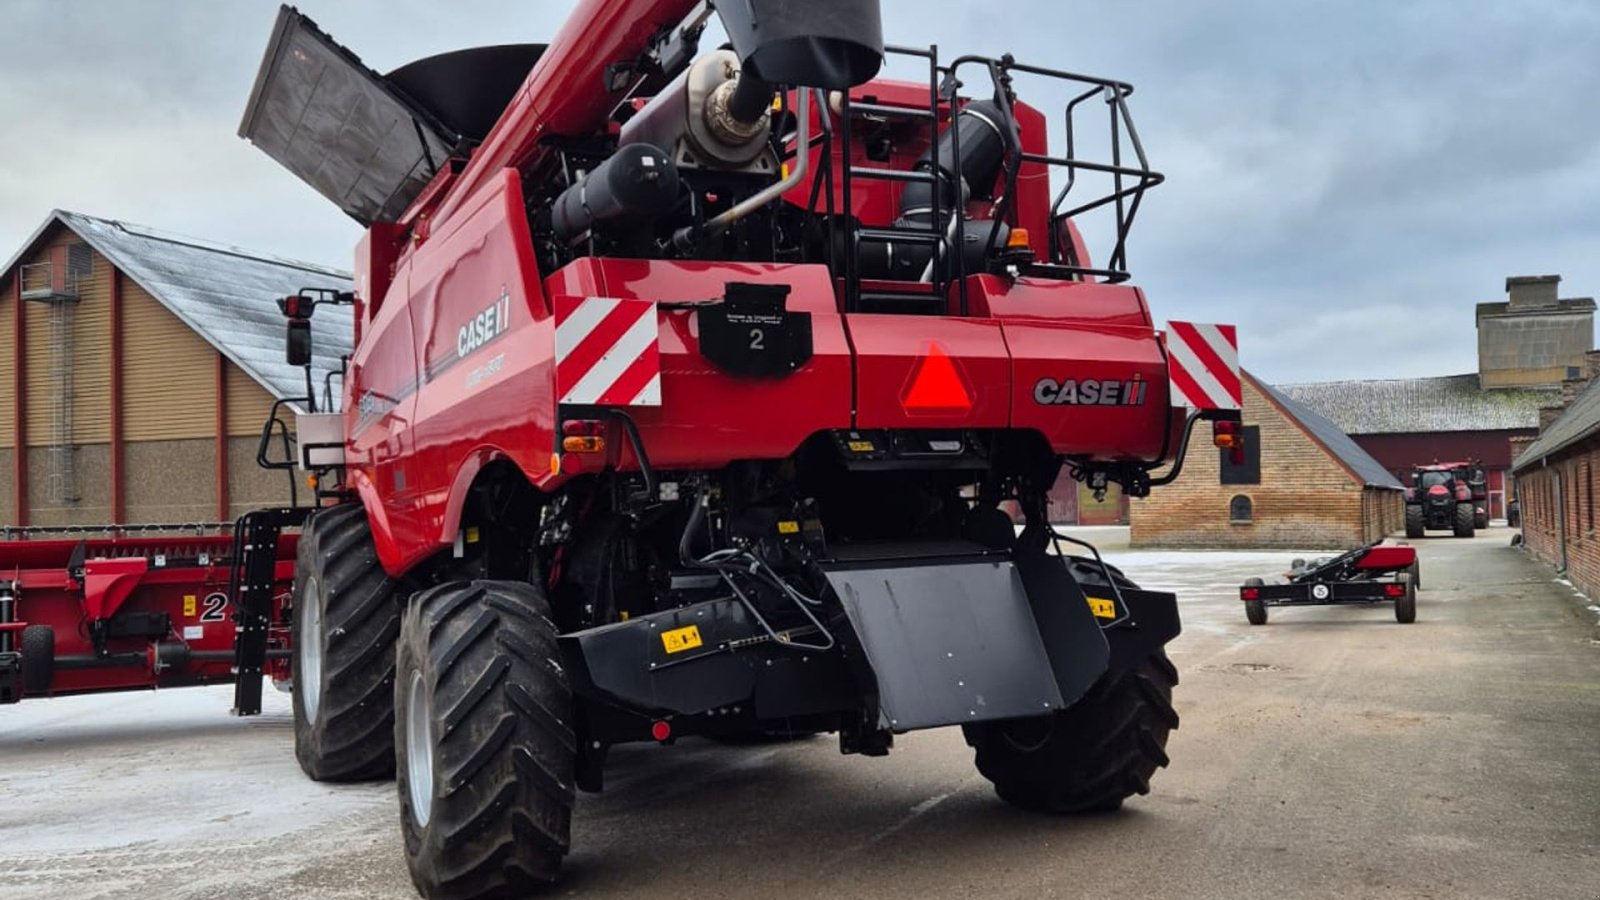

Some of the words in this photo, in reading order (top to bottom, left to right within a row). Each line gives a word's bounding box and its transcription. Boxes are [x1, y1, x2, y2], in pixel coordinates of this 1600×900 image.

[457, 305, 496, 358] CASE
[749, 328, 765, 350] 2
[1034, 378, 1120, 405] CASE
[200, 592, 229, 622] 2
